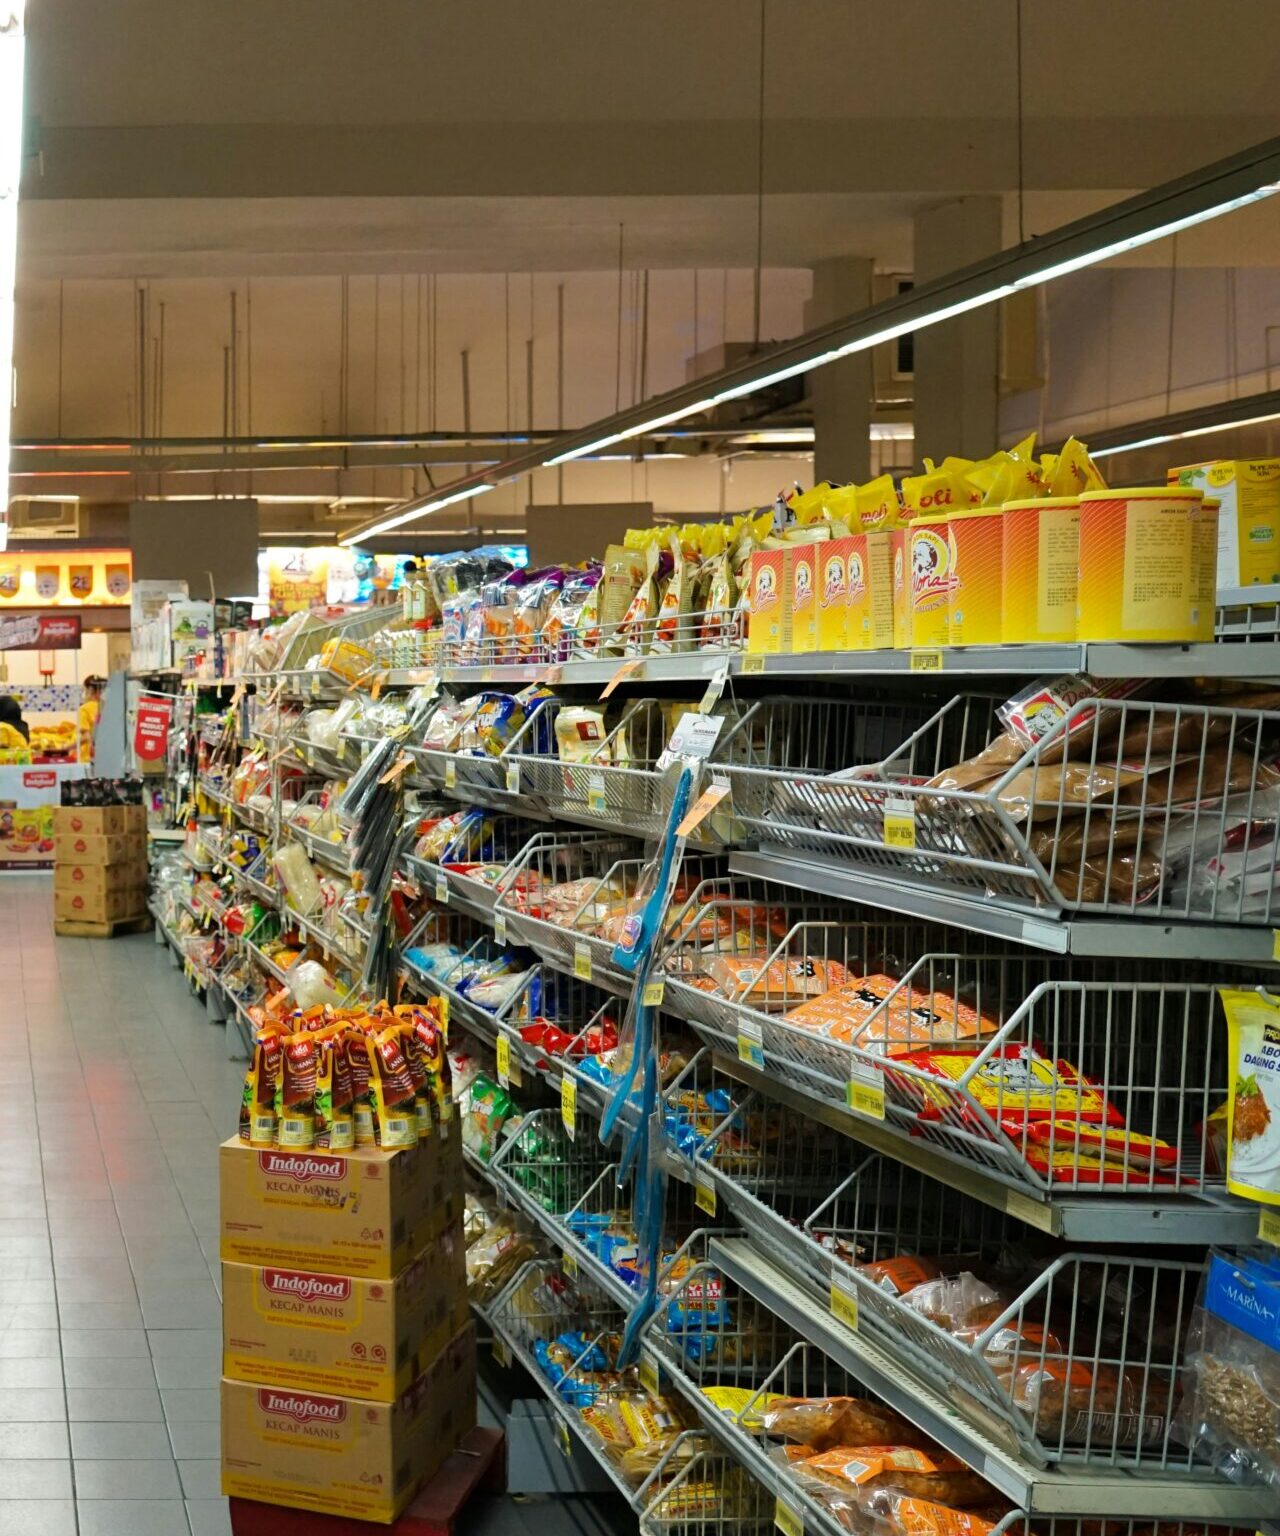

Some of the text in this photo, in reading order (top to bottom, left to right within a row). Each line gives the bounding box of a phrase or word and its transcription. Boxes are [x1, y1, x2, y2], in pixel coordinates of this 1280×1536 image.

[1244, 1053, 1276, 1070] DAGING
[267, 1156, 341, 1178] Indofood
[266, 1181, 341, 1198] KECAP MANIS
[272, 1274, 345, 1297] Indofood
[270, 1300, 345, 1318] KECAP MANIS
[267, 1394, 340, 1418] Indofood
[265, 1419, 341, 1440] KECAP MANIS
